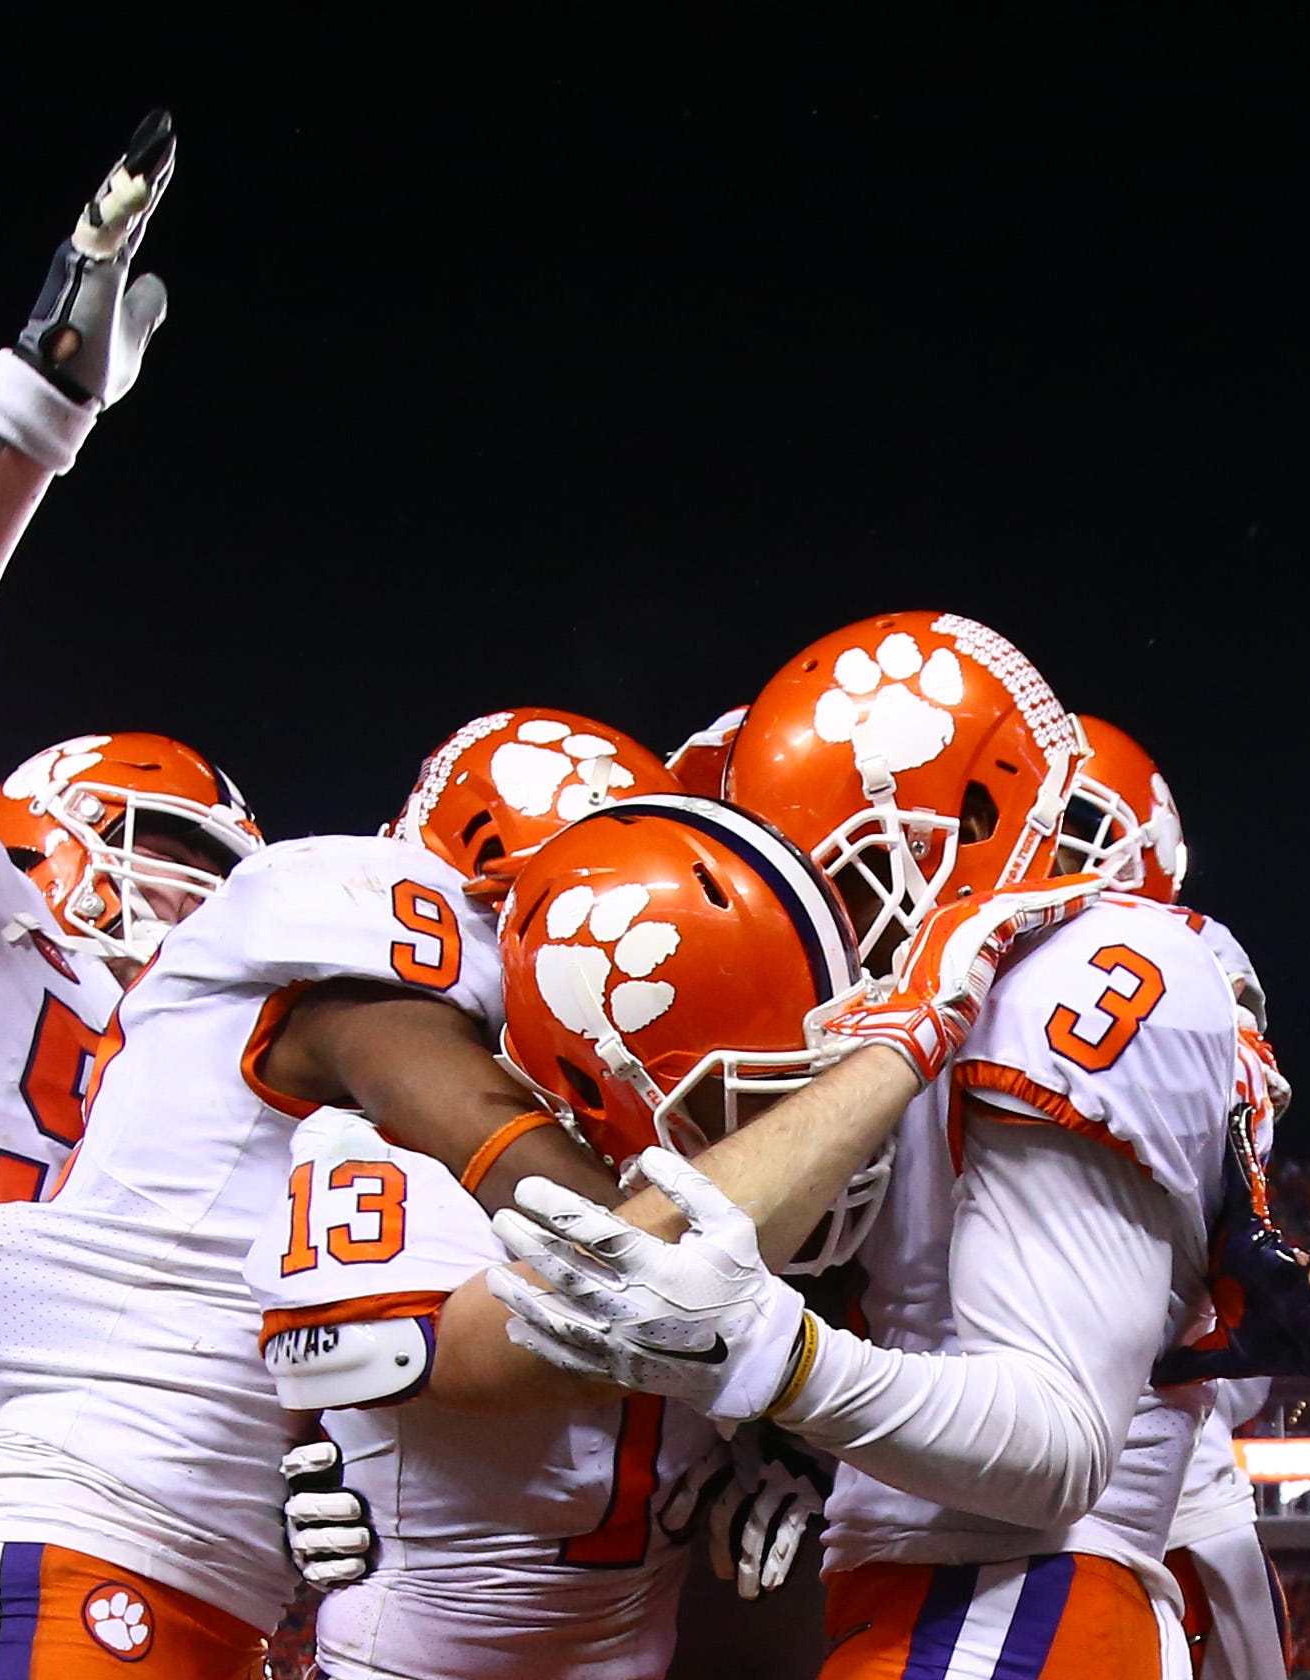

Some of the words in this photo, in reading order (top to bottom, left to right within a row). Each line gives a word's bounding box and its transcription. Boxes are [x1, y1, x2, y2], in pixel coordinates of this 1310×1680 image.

[390, 878, 462, 992] 9
[1045, 943, 1166, 1072] 3
[280, 1160, 407, 1277] 13
